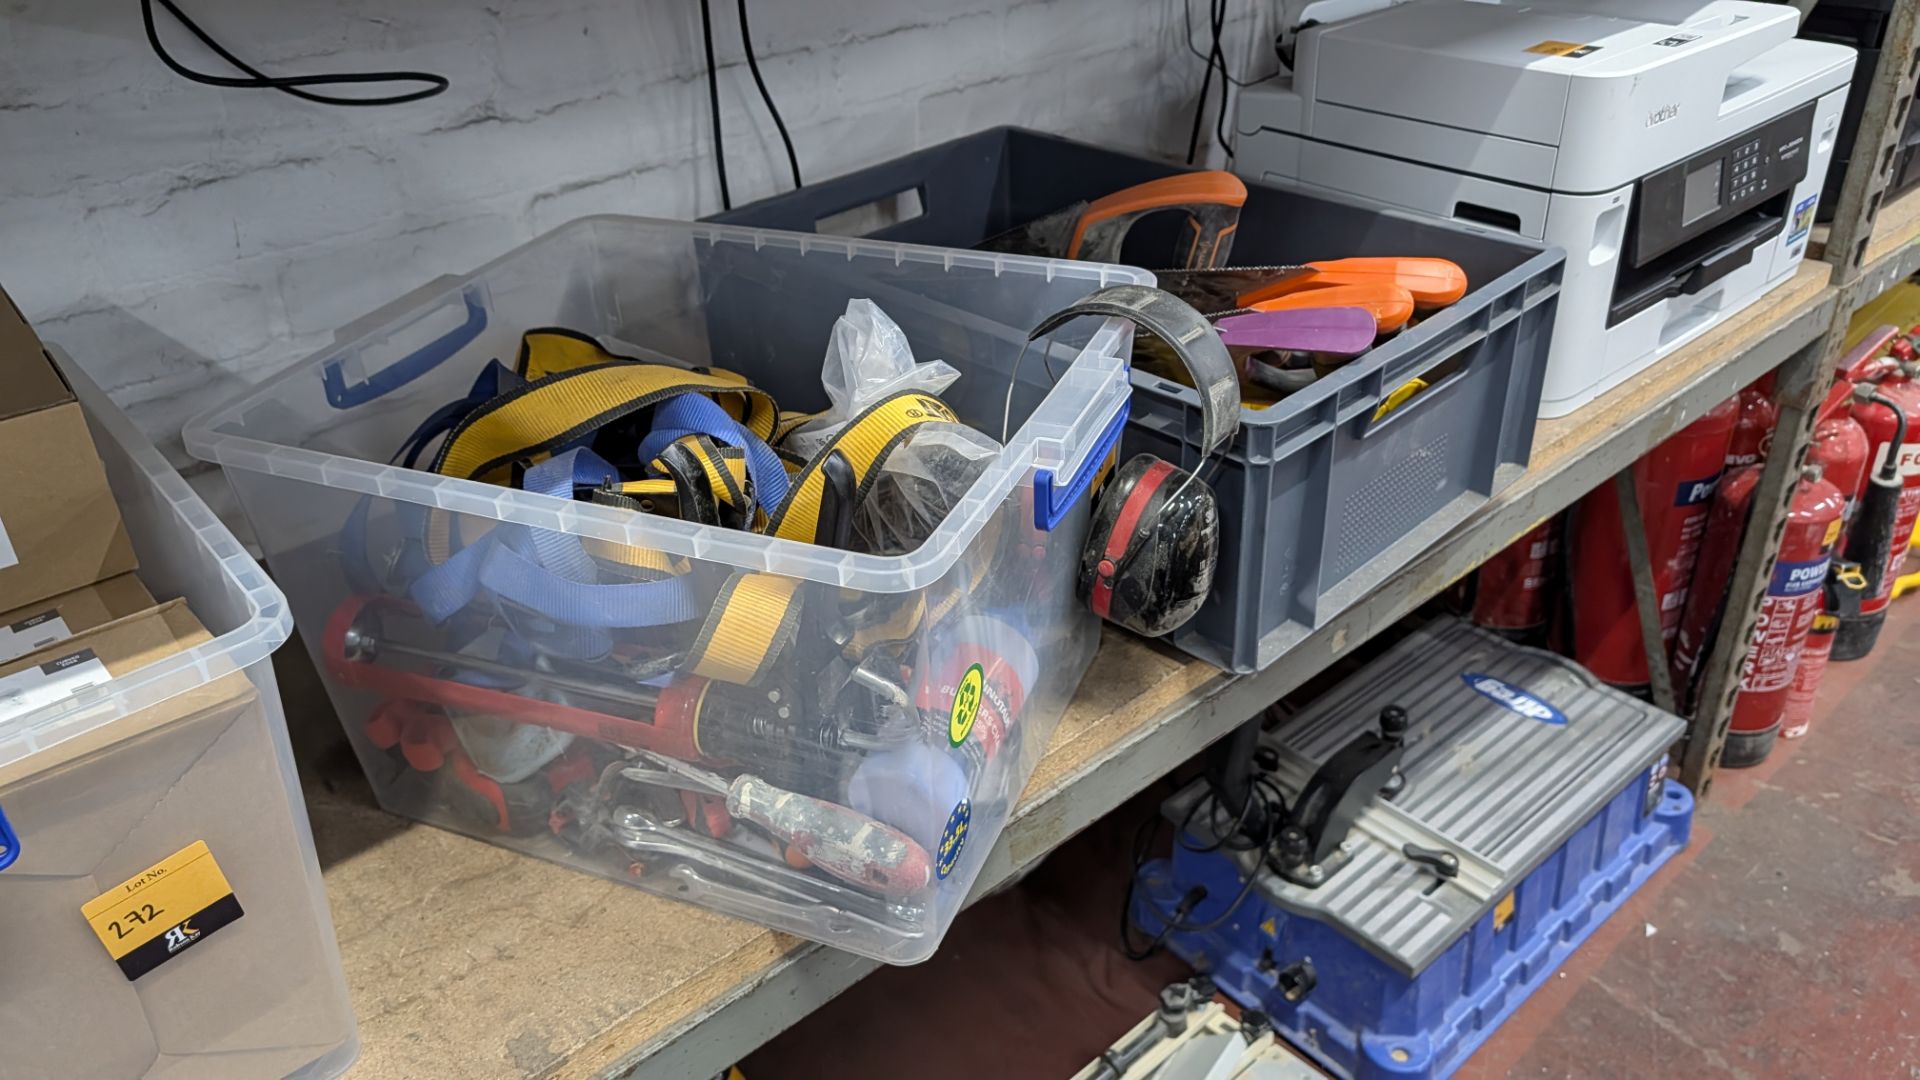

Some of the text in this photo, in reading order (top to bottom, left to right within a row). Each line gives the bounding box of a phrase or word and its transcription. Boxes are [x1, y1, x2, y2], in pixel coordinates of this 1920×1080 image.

[125, 866, 167, 893] Lot No.
[108, 904, 165, 940] 272
